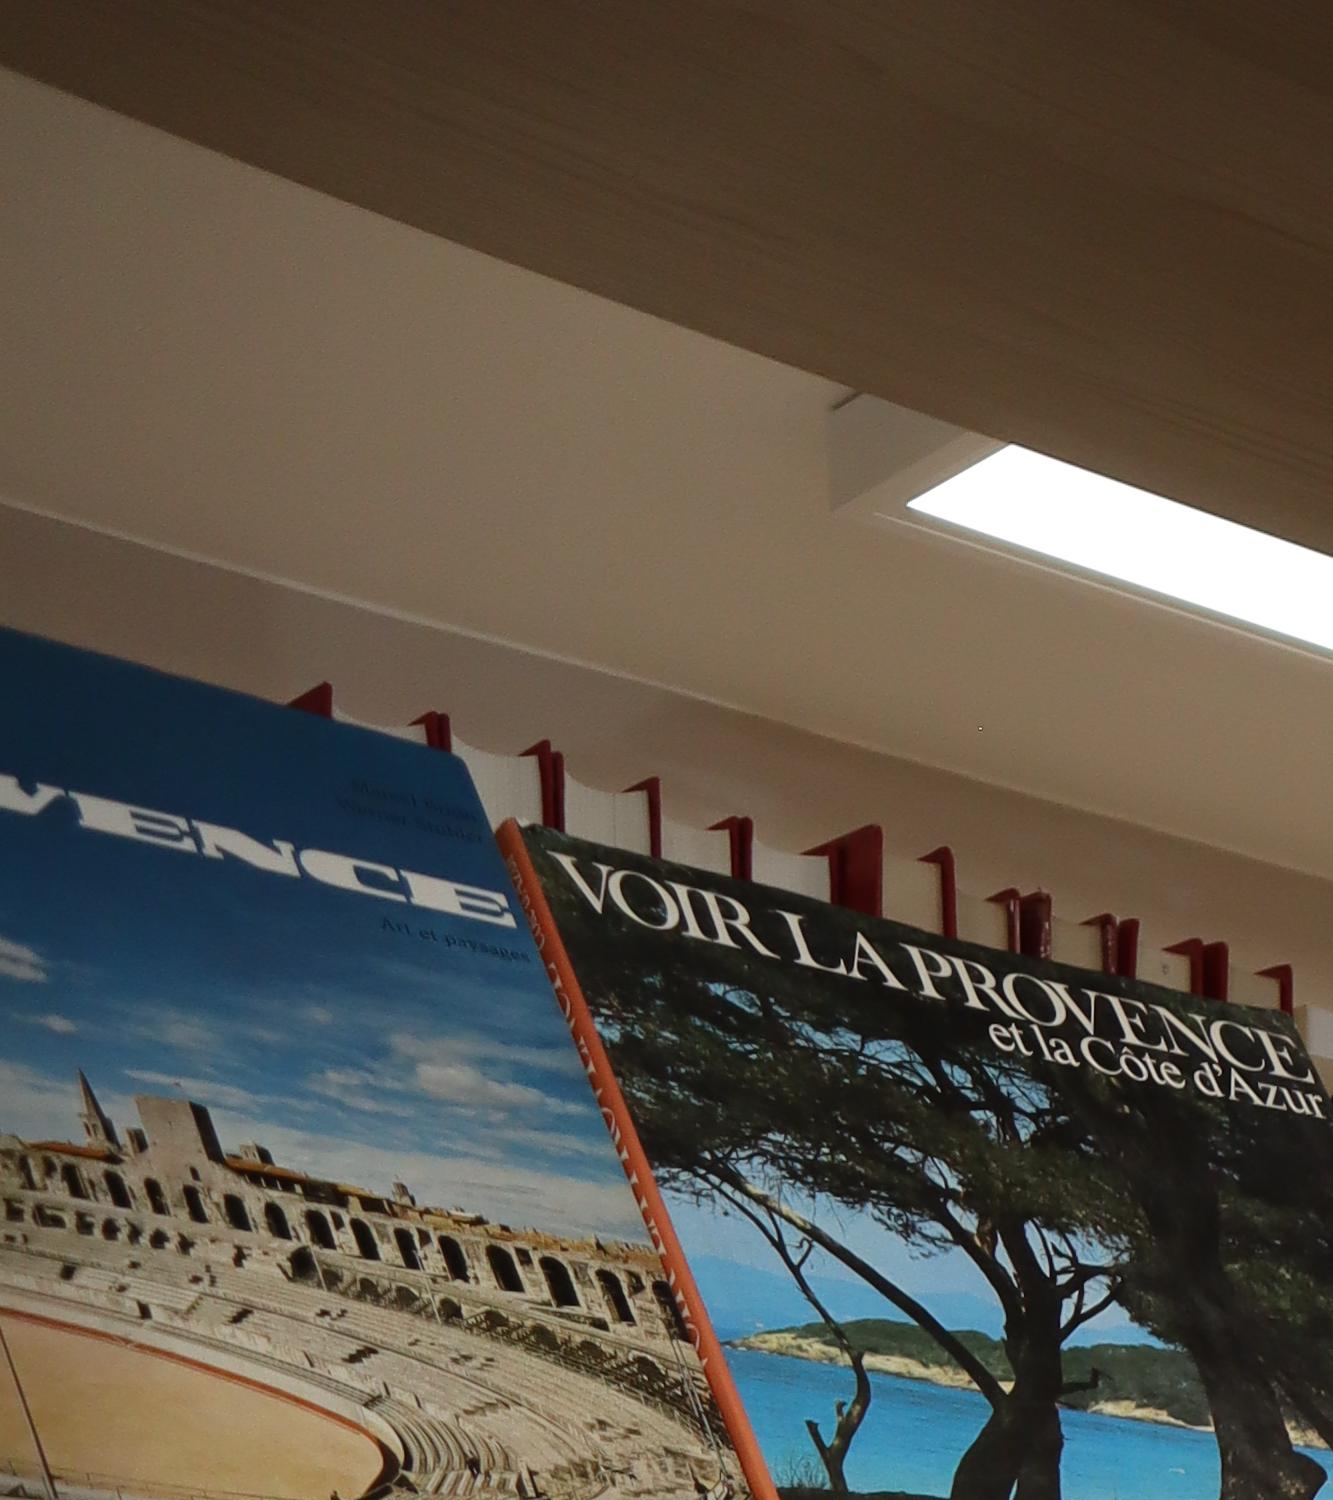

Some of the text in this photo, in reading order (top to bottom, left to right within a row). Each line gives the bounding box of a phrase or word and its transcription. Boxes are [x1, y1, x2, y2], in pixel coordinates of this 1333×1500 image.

[547, 850, 1314, 1082] VOIR LA PROVENCE
[989, 1019, 1324, 1119] et la Côte d'Azur
